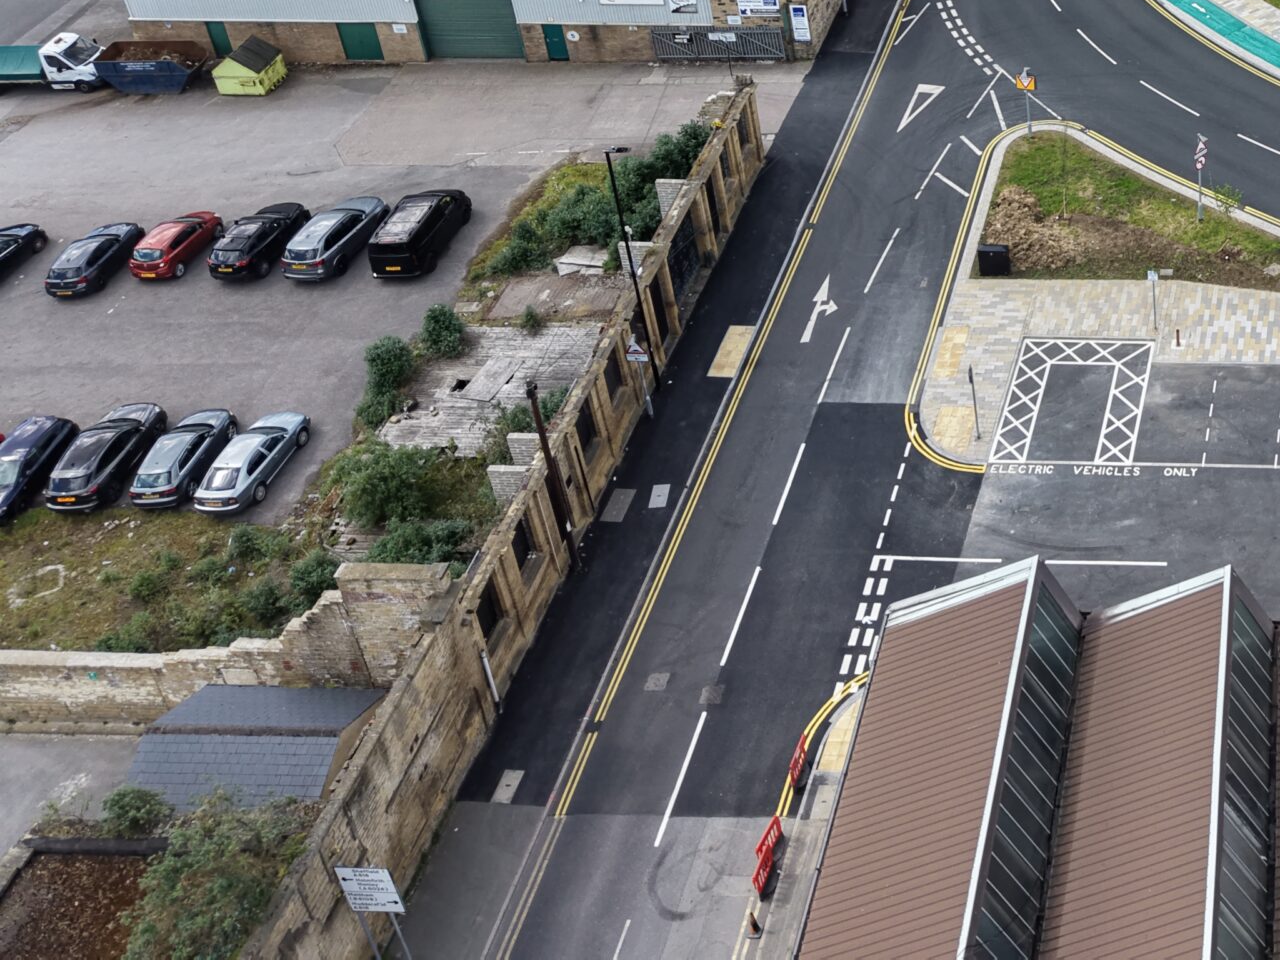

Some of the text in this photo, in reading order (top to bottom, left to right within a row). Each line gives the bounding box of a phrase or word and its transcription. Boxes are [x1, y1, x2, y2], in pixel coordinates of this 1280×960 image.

[989, 465, 1198, 478] ELECTRIC VEHICLES ONLY
